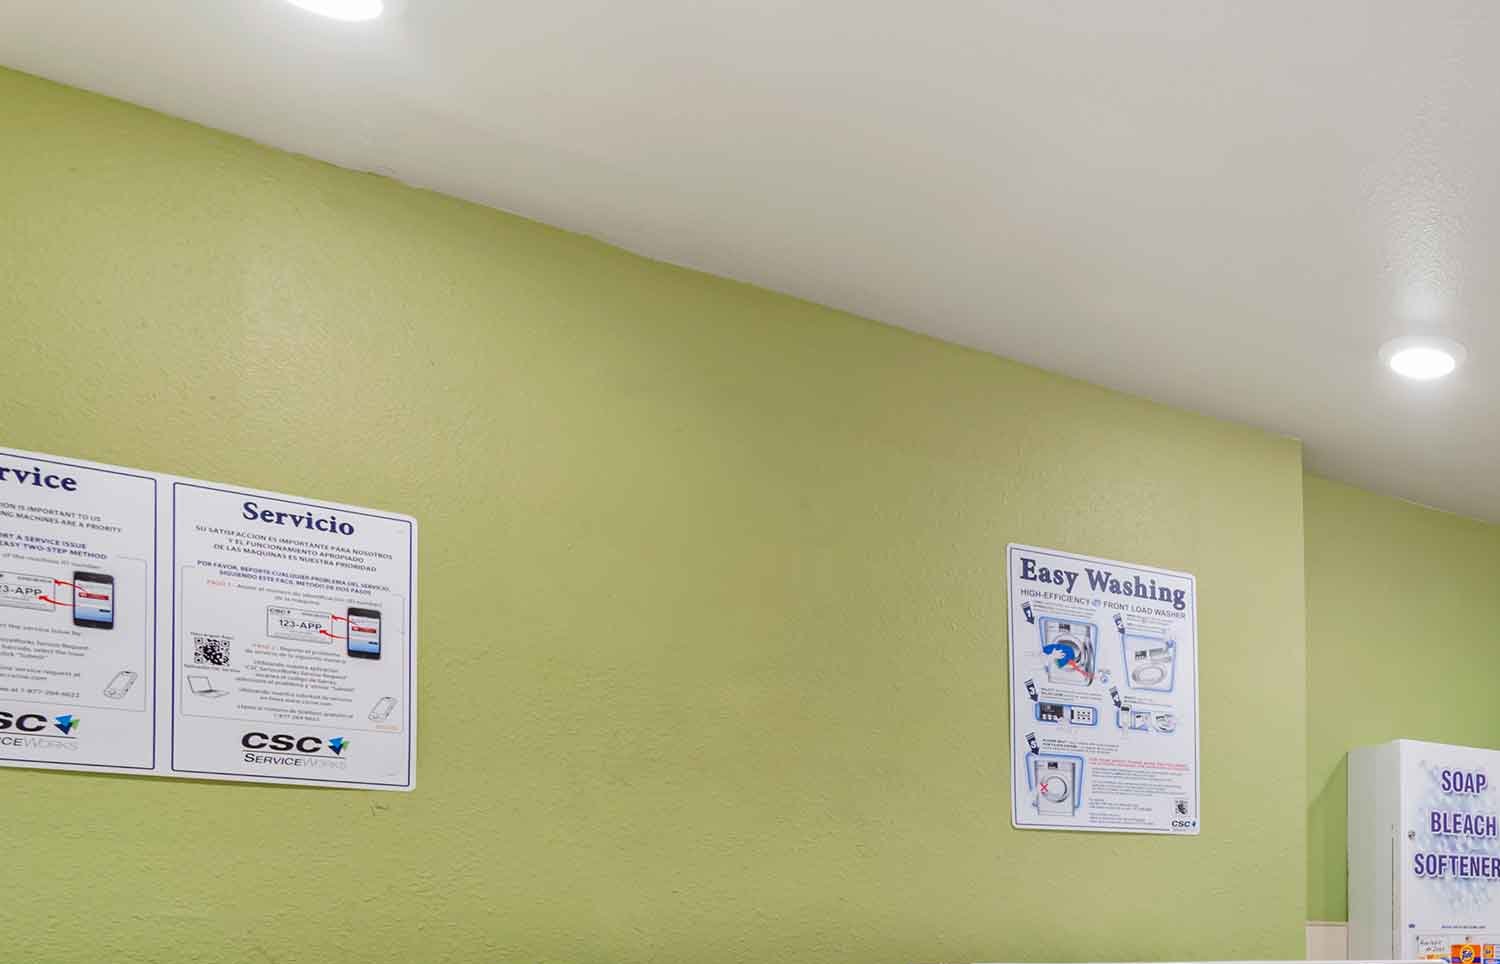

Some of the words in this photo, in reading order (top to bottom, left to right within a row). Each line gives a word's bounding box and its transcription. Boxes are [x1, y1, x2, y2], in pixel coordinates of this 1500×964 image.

[16, 512, 59, 525] MACHINES
[61, 519, 76, 527] ARE
[86, 523, 122, 533] PRIORITY
[27, 506, 75, 518] IMPORTANT
[242, 502, 355, 536] Servicio
[23, 543, 68, 554] TWO-STEP
[25, 536, 60, 546] SERVICE
[62, 541, 87, 549] ISSUE
[246, 541, 318, 556] FUNCIONAMIENTO
[279, 538, 328, 550] IMPORTANTE
[330, 546, 350, 554] PARA
[352, 549, 393, 560] NOSOTROS
[197, 559, 212, 567] POR
[299, 556, 334, 567] NUESTRA
[336, 561, 377, 572] PRIORIDAD
[1020, 557, 1079, 593] Easy
[1084, 568, 1186, 610] Washing
[1020, 589, 1090, 605] HIGH-EFFICIENCY
[1103, 600, 1129, 612] FRONT
[1131, 606, 1153, 616] LOAD
[1154, 609, 1185, 619] WASHER
[280, 619, 322, 630] 123-APP
[241, 732, 323, 753] CSC
[1441, 769, 1487, 794] SOAP
[1431, 811, 1497, 837] BLEACH
